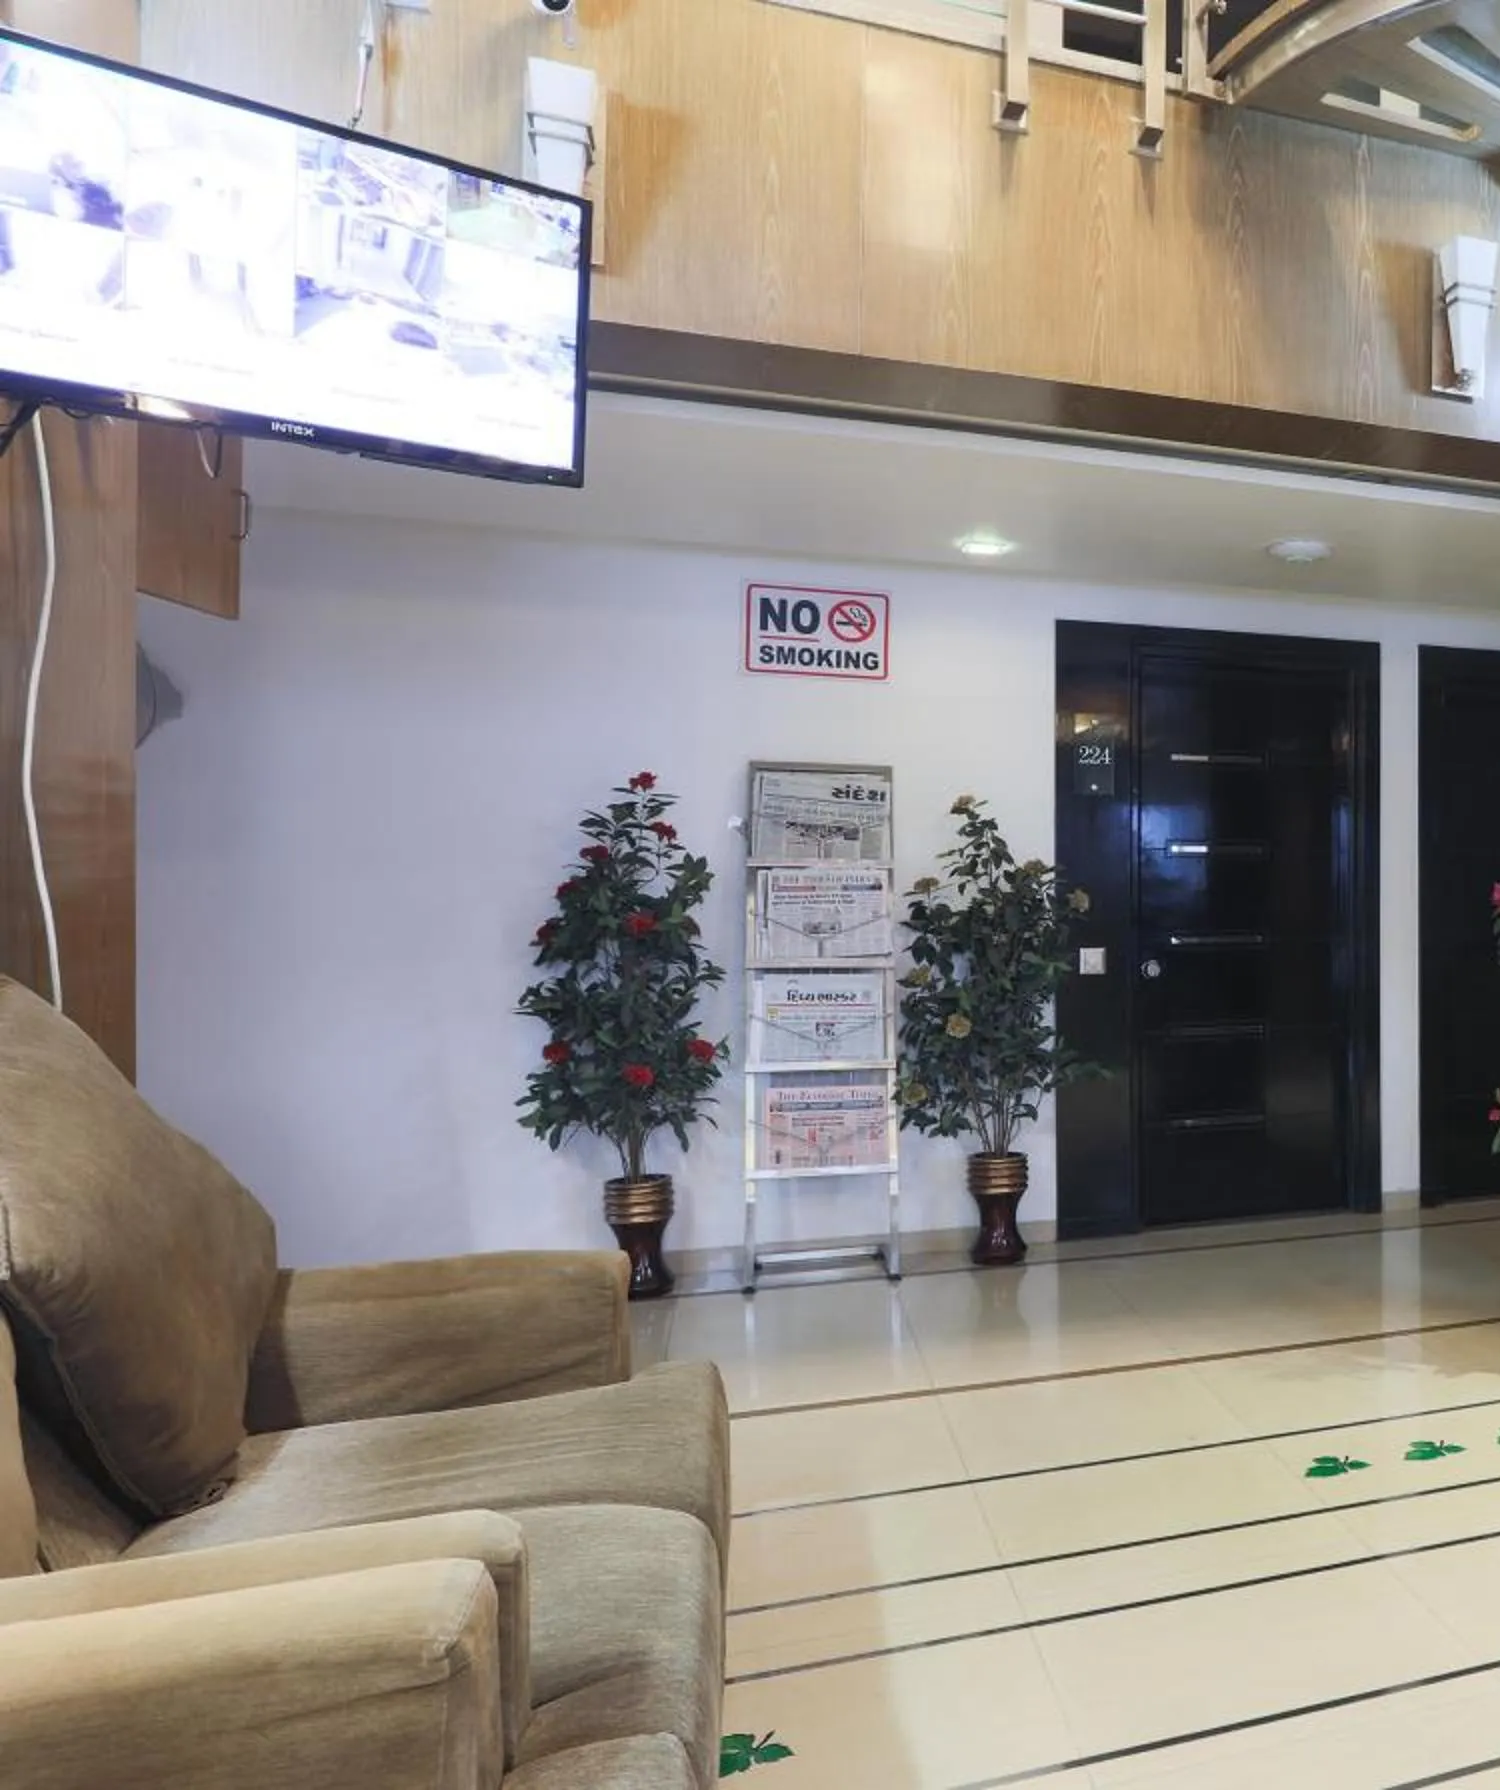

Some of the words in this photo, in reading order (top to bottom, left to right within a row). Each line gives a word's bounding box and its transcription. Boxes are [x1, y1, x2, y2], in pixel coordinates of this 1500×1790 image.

[759, 597, 820, 634] NO
[759, 645, 879, 671] SMOKING
[1079, 745, 1113, 764] 224
